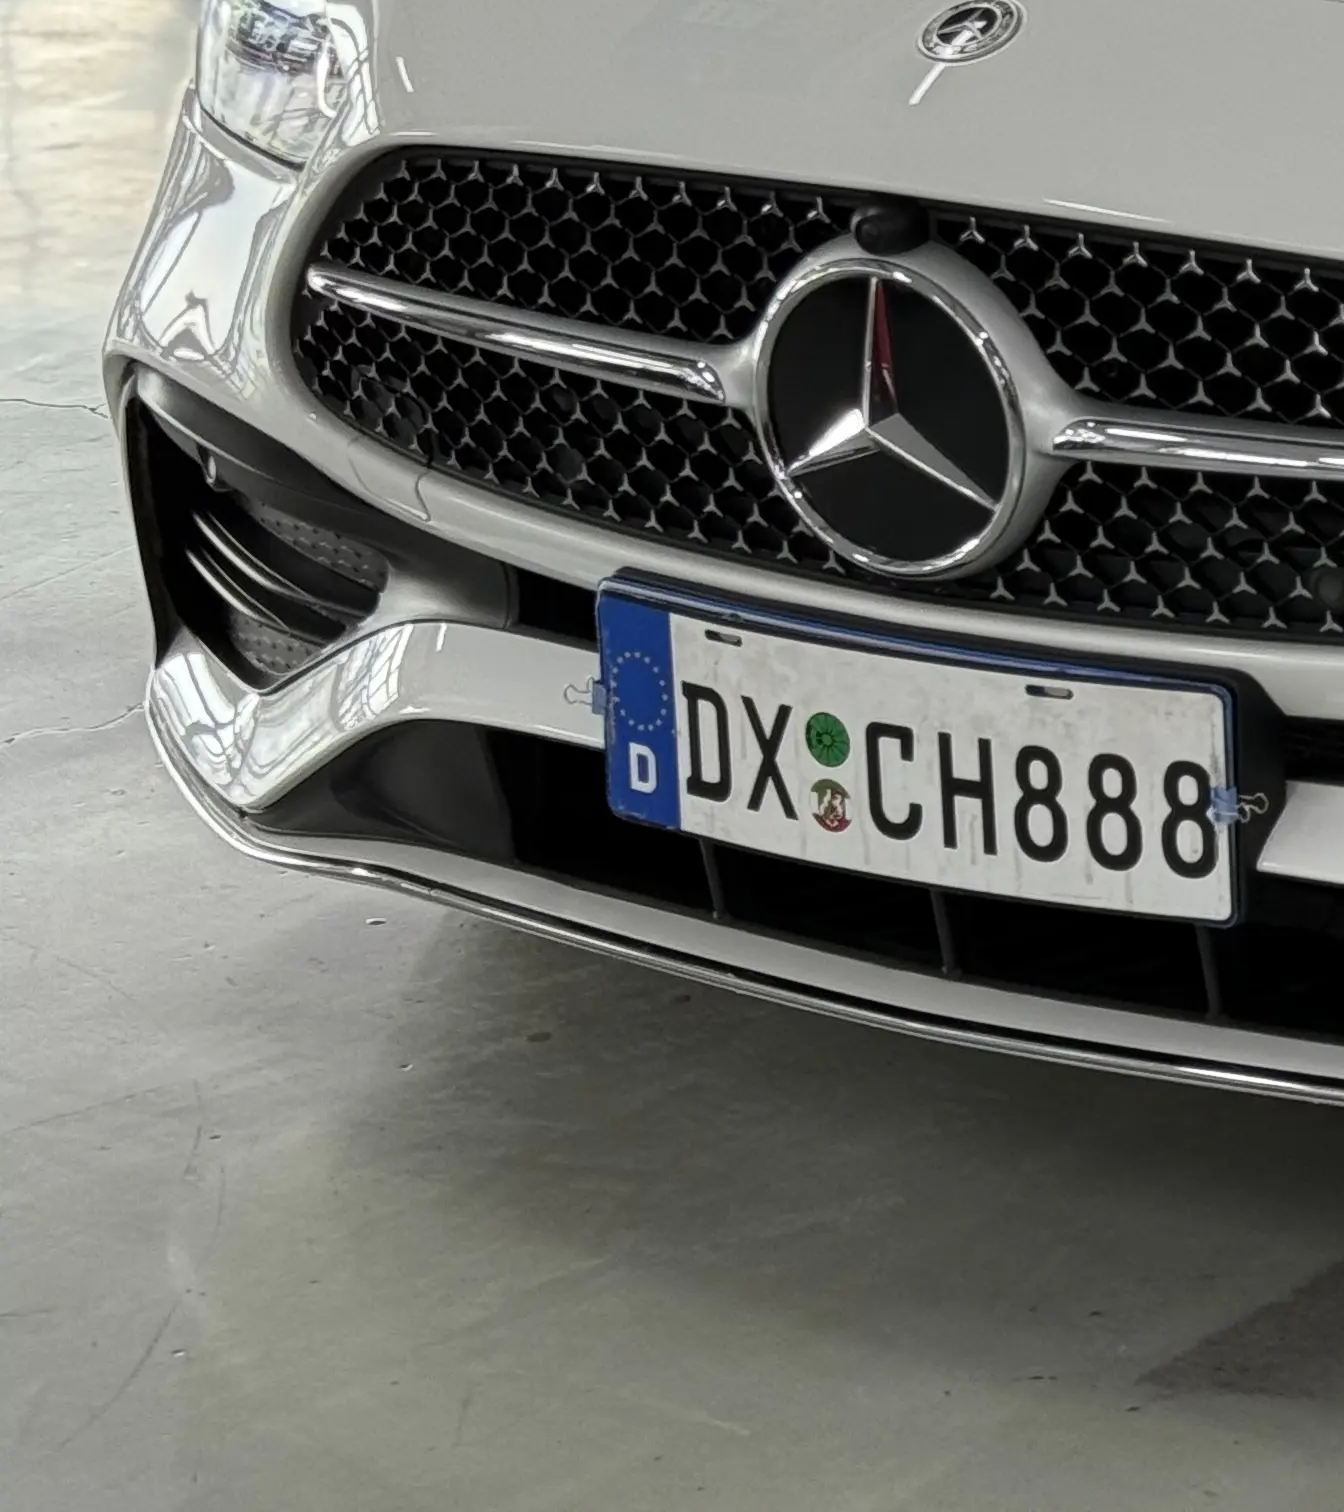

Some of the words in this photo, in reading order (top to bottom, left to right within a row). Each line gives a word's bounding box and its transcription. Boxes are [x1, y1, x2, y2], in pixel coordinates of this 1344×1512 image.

[629, 742, 657, 794] D
[681, 681, 799, 821] DX
[865, 720, 1221, 879] CH888
